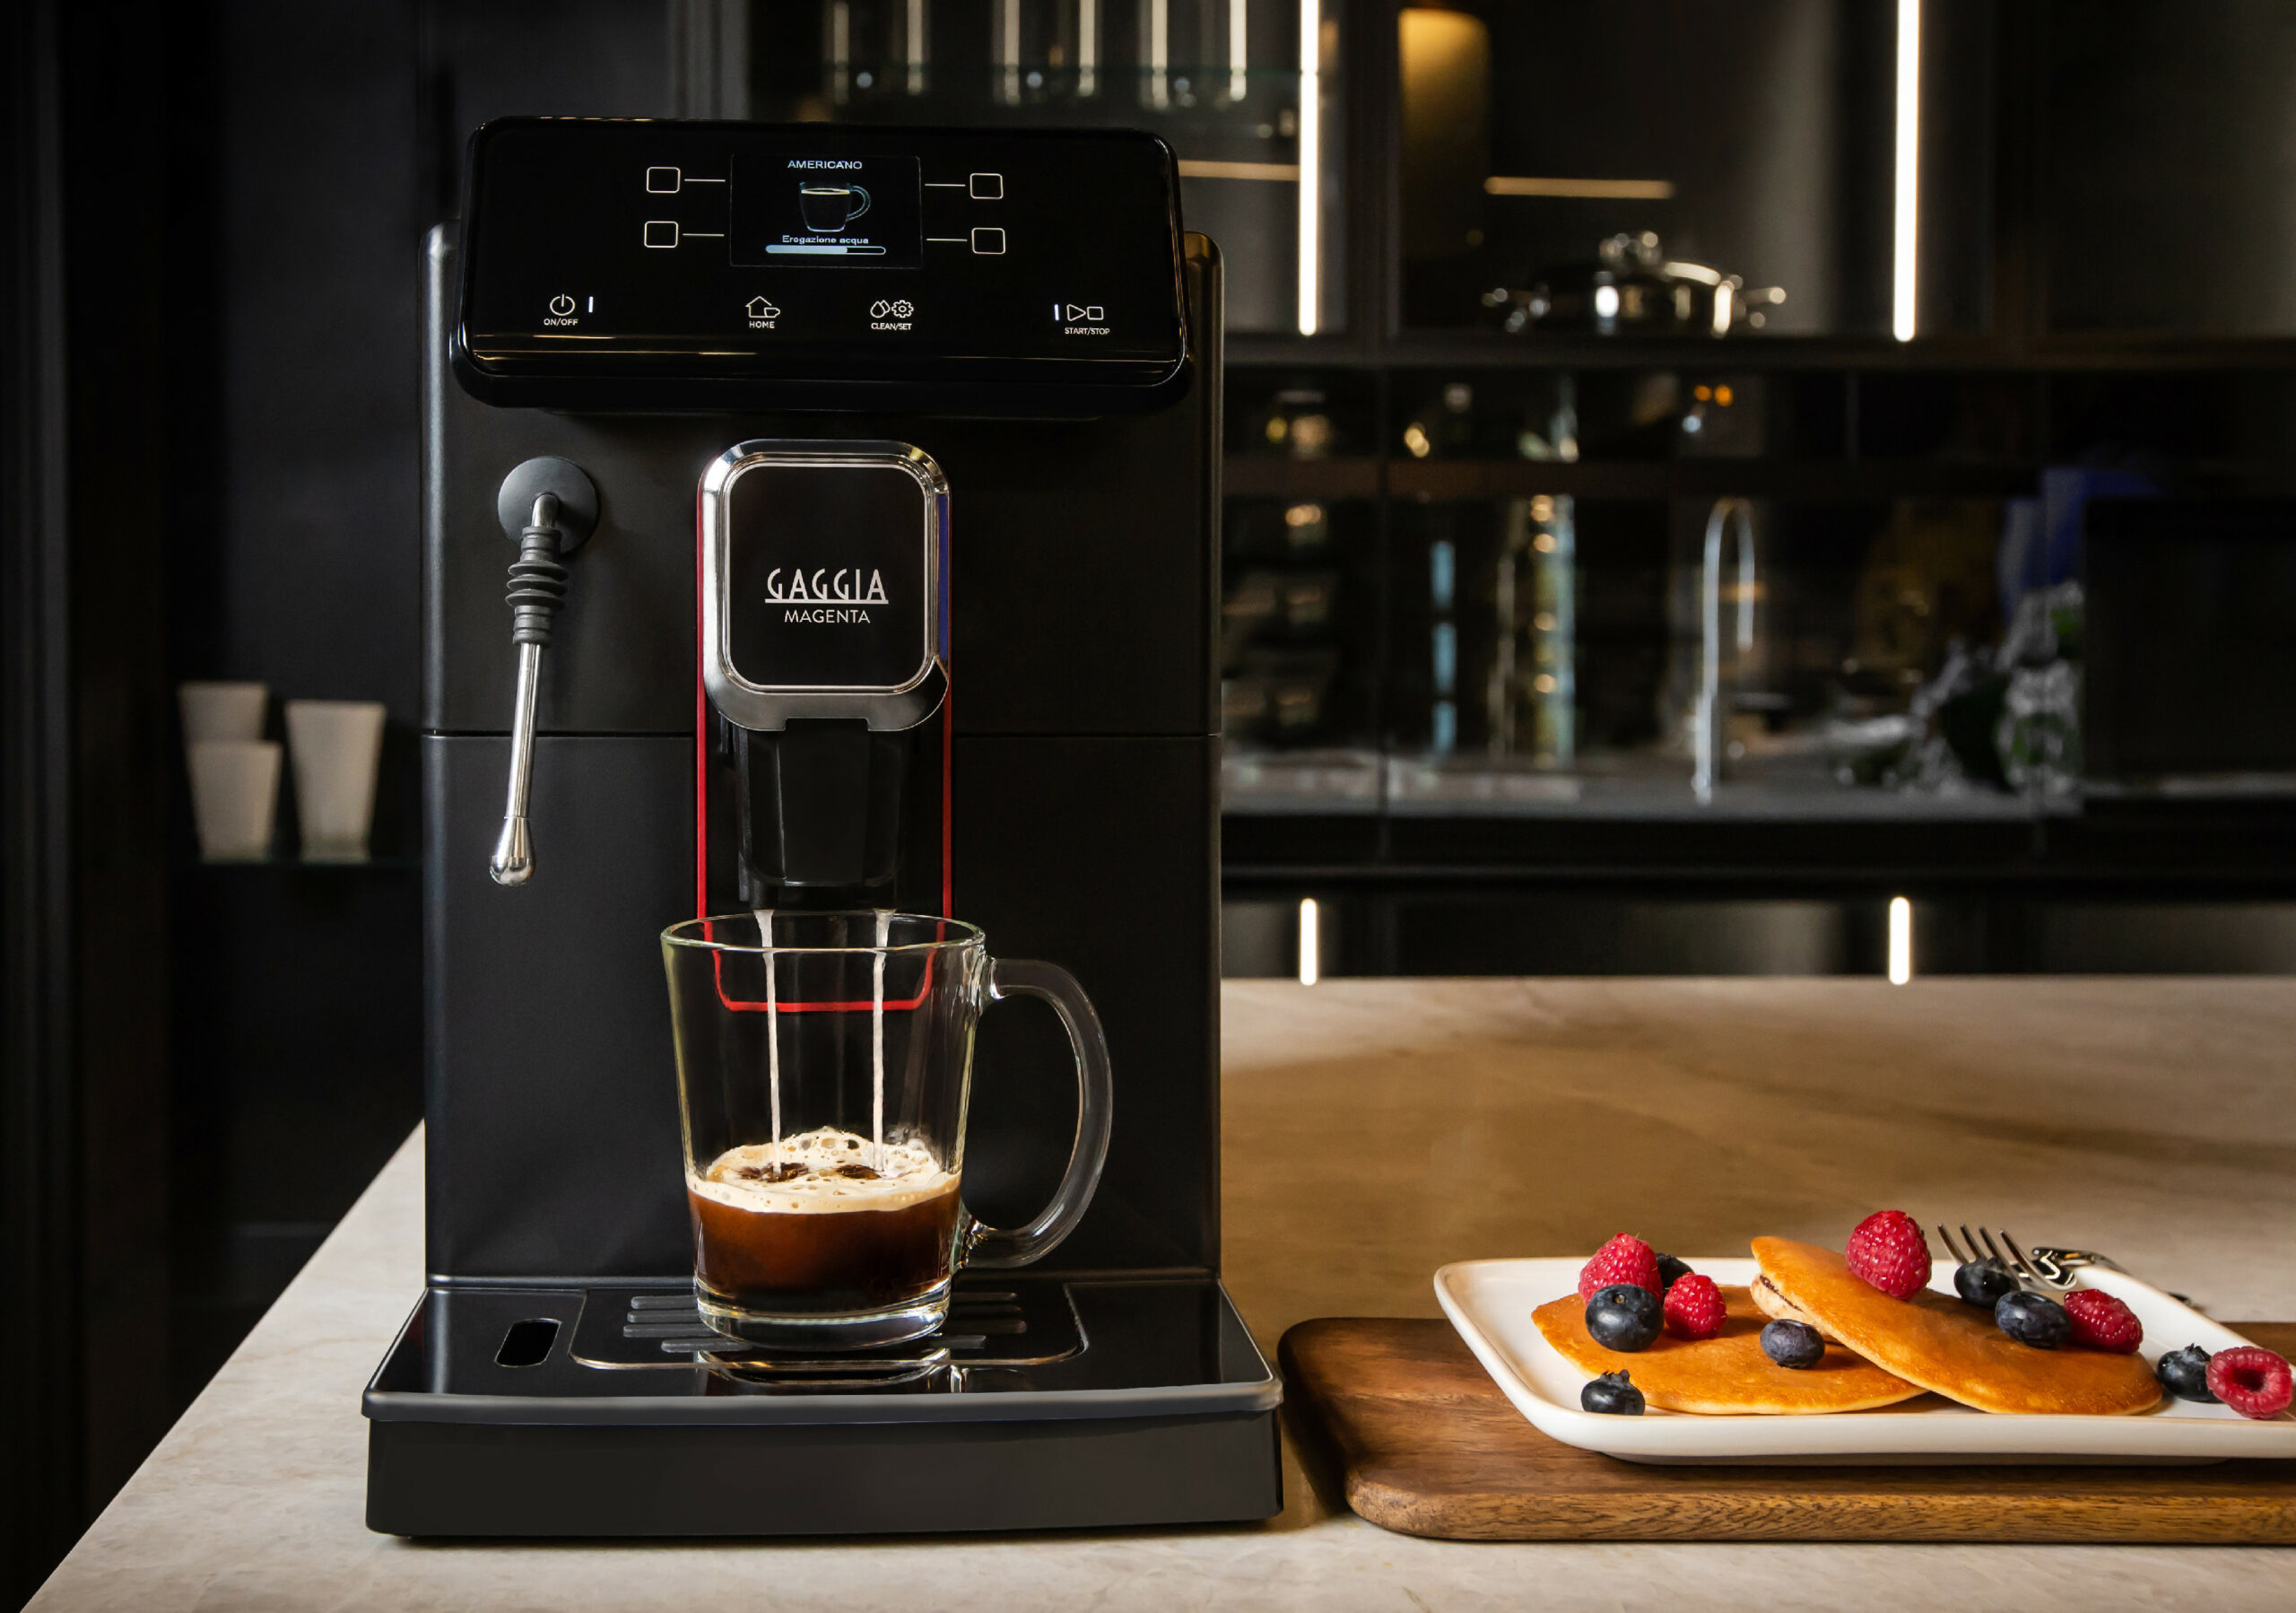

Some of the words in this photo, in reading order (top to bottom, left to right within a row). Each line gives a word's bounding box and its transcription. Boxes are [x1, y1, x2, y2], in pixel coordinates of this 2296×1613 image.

[787, 160, 863, 170] AMERICANO
[544, 318, 578, 327] ON/OFF
[749, 320, 775, 329] HOME
[871, 322, 912, 330] CLEAN/SET
[1065, 327, 1110, 336] START/STOP
[765, 568, 889, 604] GAGGIA
[784, 609, 871, 623] MAGENTA
